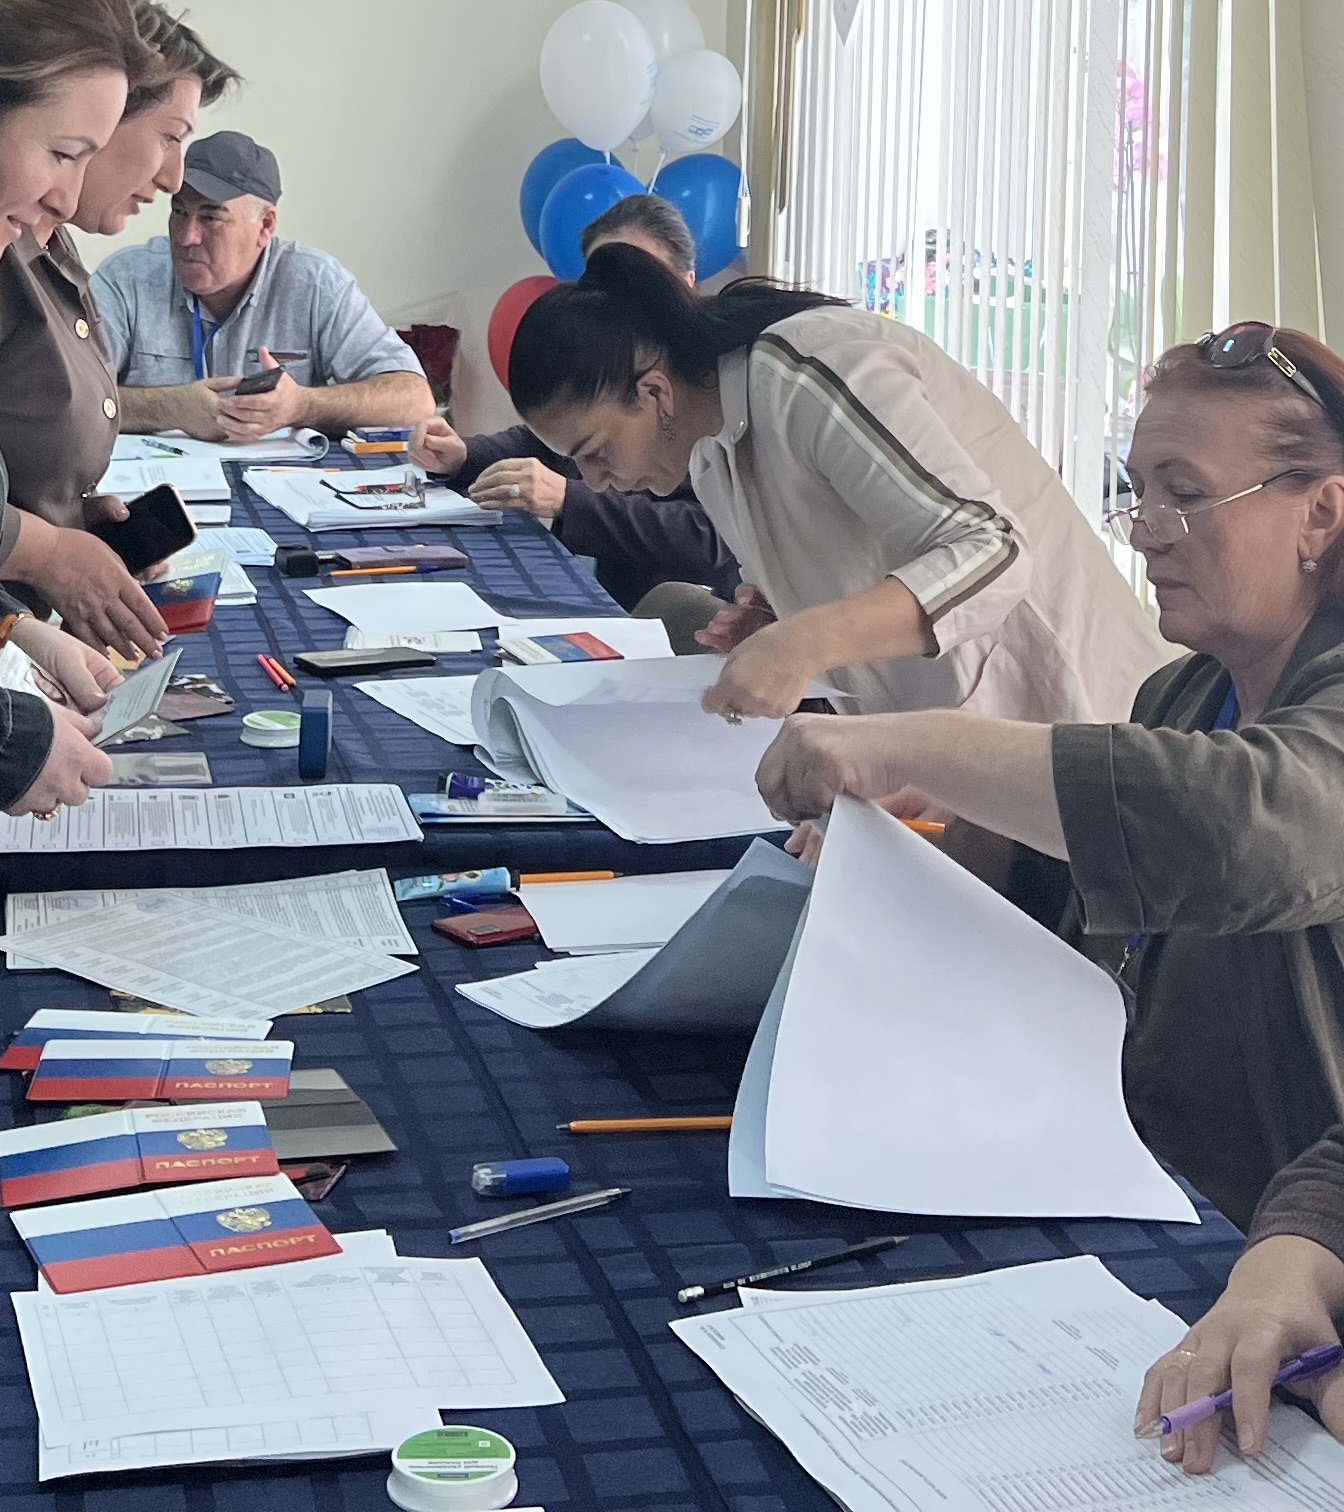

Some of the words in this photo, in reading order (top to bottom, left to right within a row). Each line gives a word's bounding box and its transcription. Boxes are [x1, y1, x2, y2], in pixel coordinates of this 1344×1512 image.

[174, 1081, 273, 1089] ПАСПОРТ
[156, 1155, 261, 1170] ПАСПОРТ
[209, 1234, 317, 1258] ПАСПОРТ
